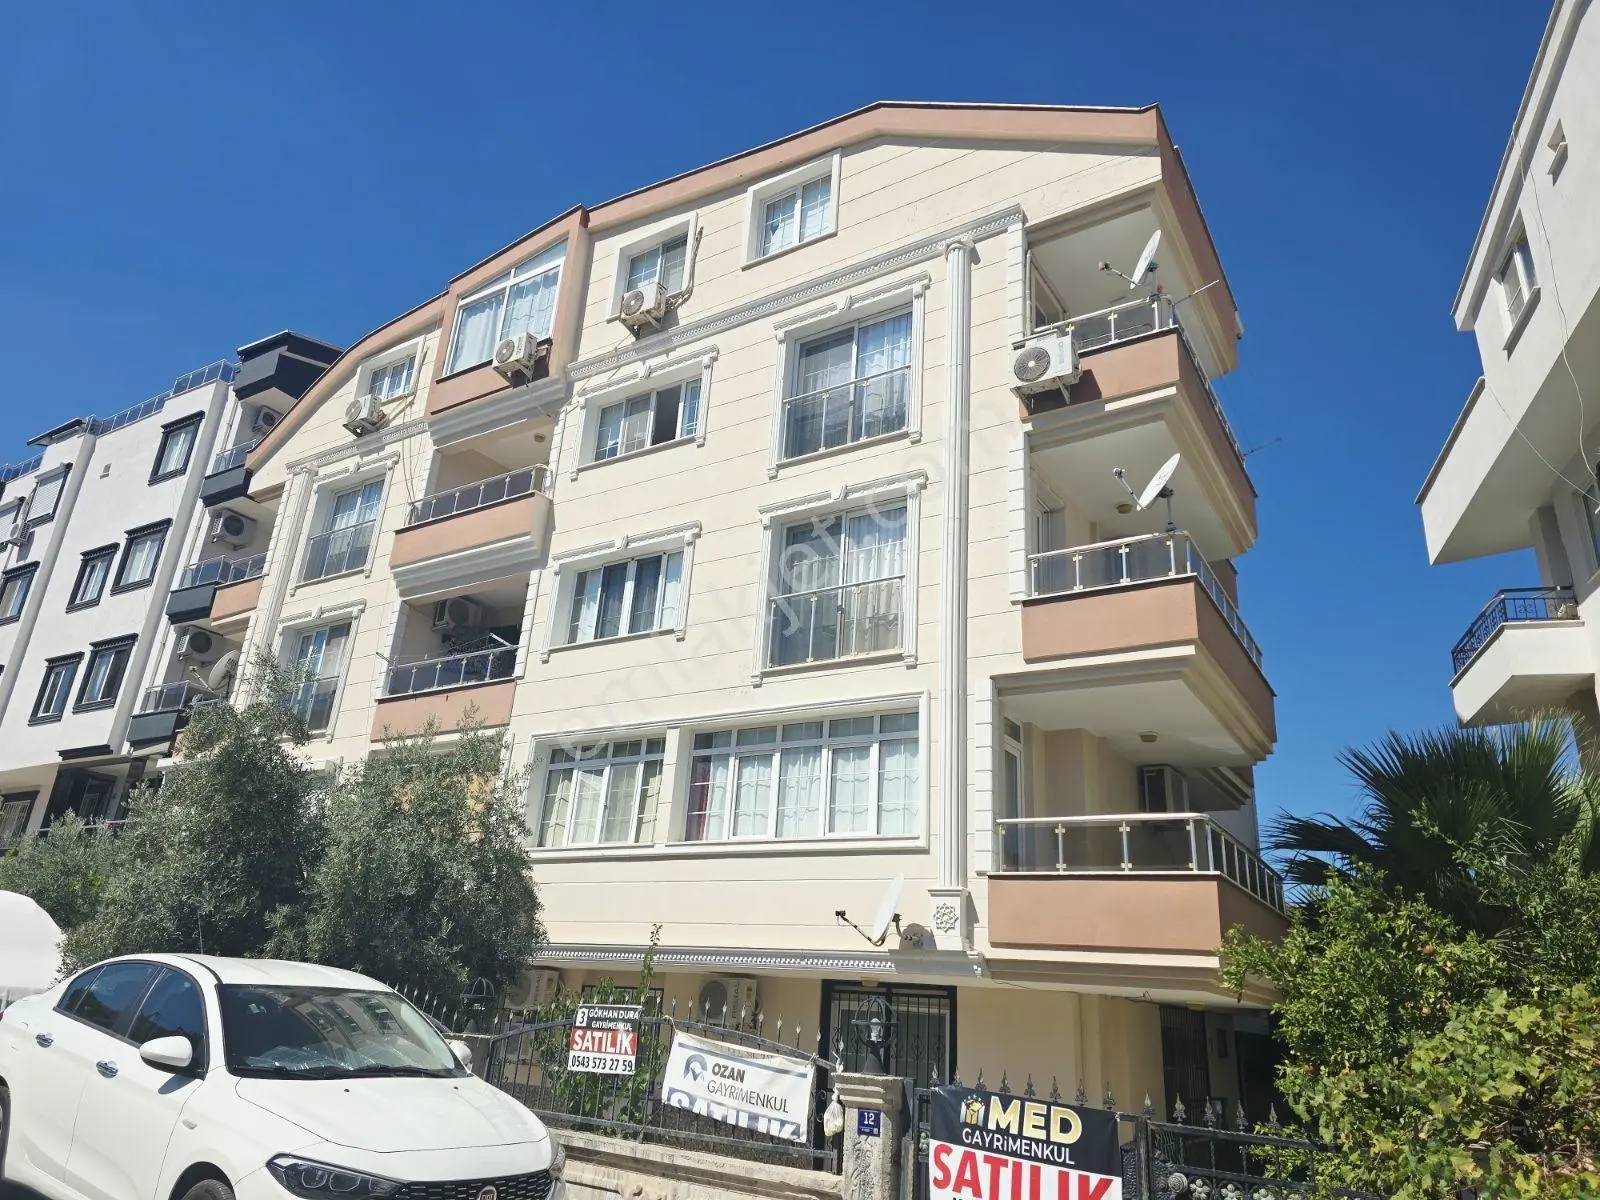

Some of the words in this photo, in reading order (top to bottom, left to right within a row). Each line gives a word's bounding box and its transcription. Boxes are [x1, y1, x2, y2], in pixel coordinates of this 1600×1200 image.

[589, 1007, 618, 1018] GÖKHAN
[573, 1030, 634, 1055] SATILIK
[571, 1055, 590, 1068] 0543
[592, 1057, 607, 1070] 573
[609, 1058, 620, 1071] 27
[622, 1060, 633, 1073] 59
[712, 1063, 746, 1083] OZAN
[863, 1112, 875, 1125] 12
[987, 1095, 1082, 1144] MED
